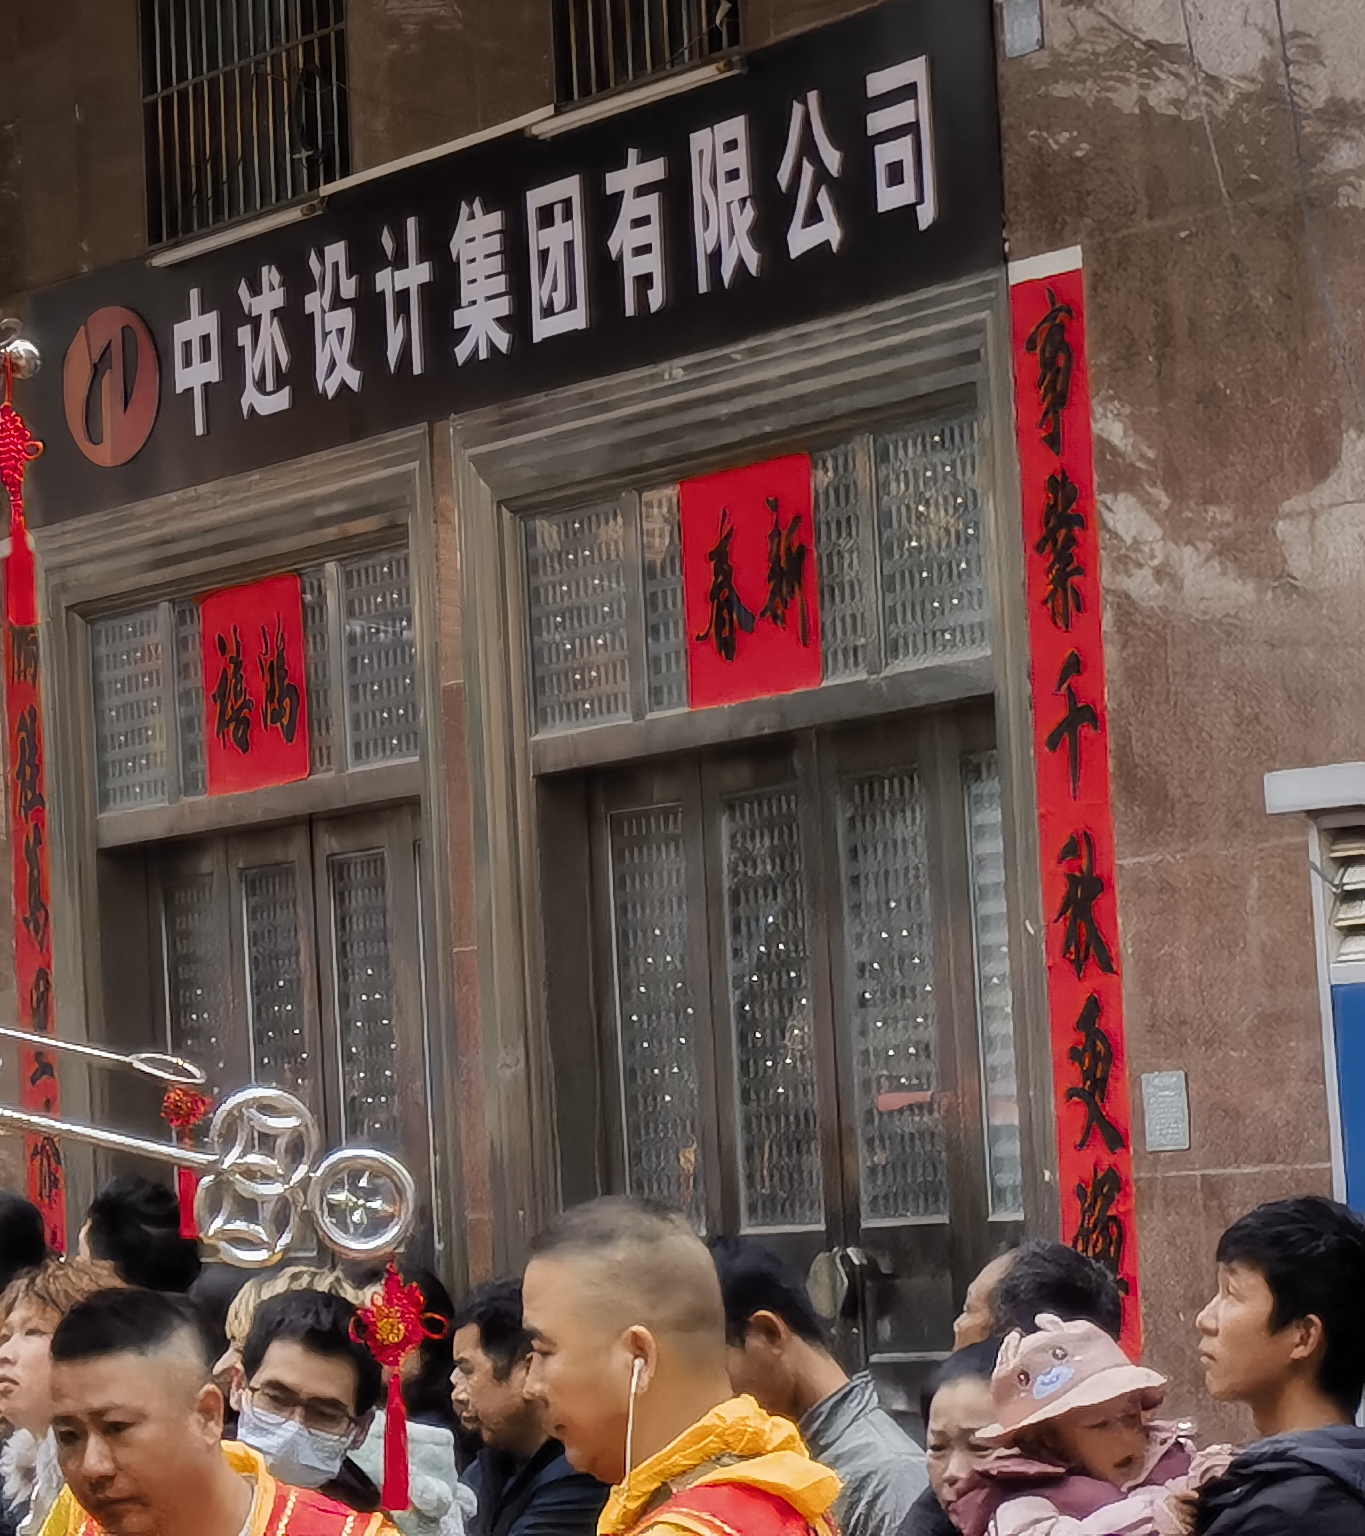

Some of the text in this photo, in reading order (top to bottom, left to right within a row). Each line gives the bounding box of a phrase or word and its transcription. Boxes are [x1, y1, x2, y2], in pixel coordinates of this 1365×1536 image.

[172, 53, 939, 437] 中述设计集团有限公司
